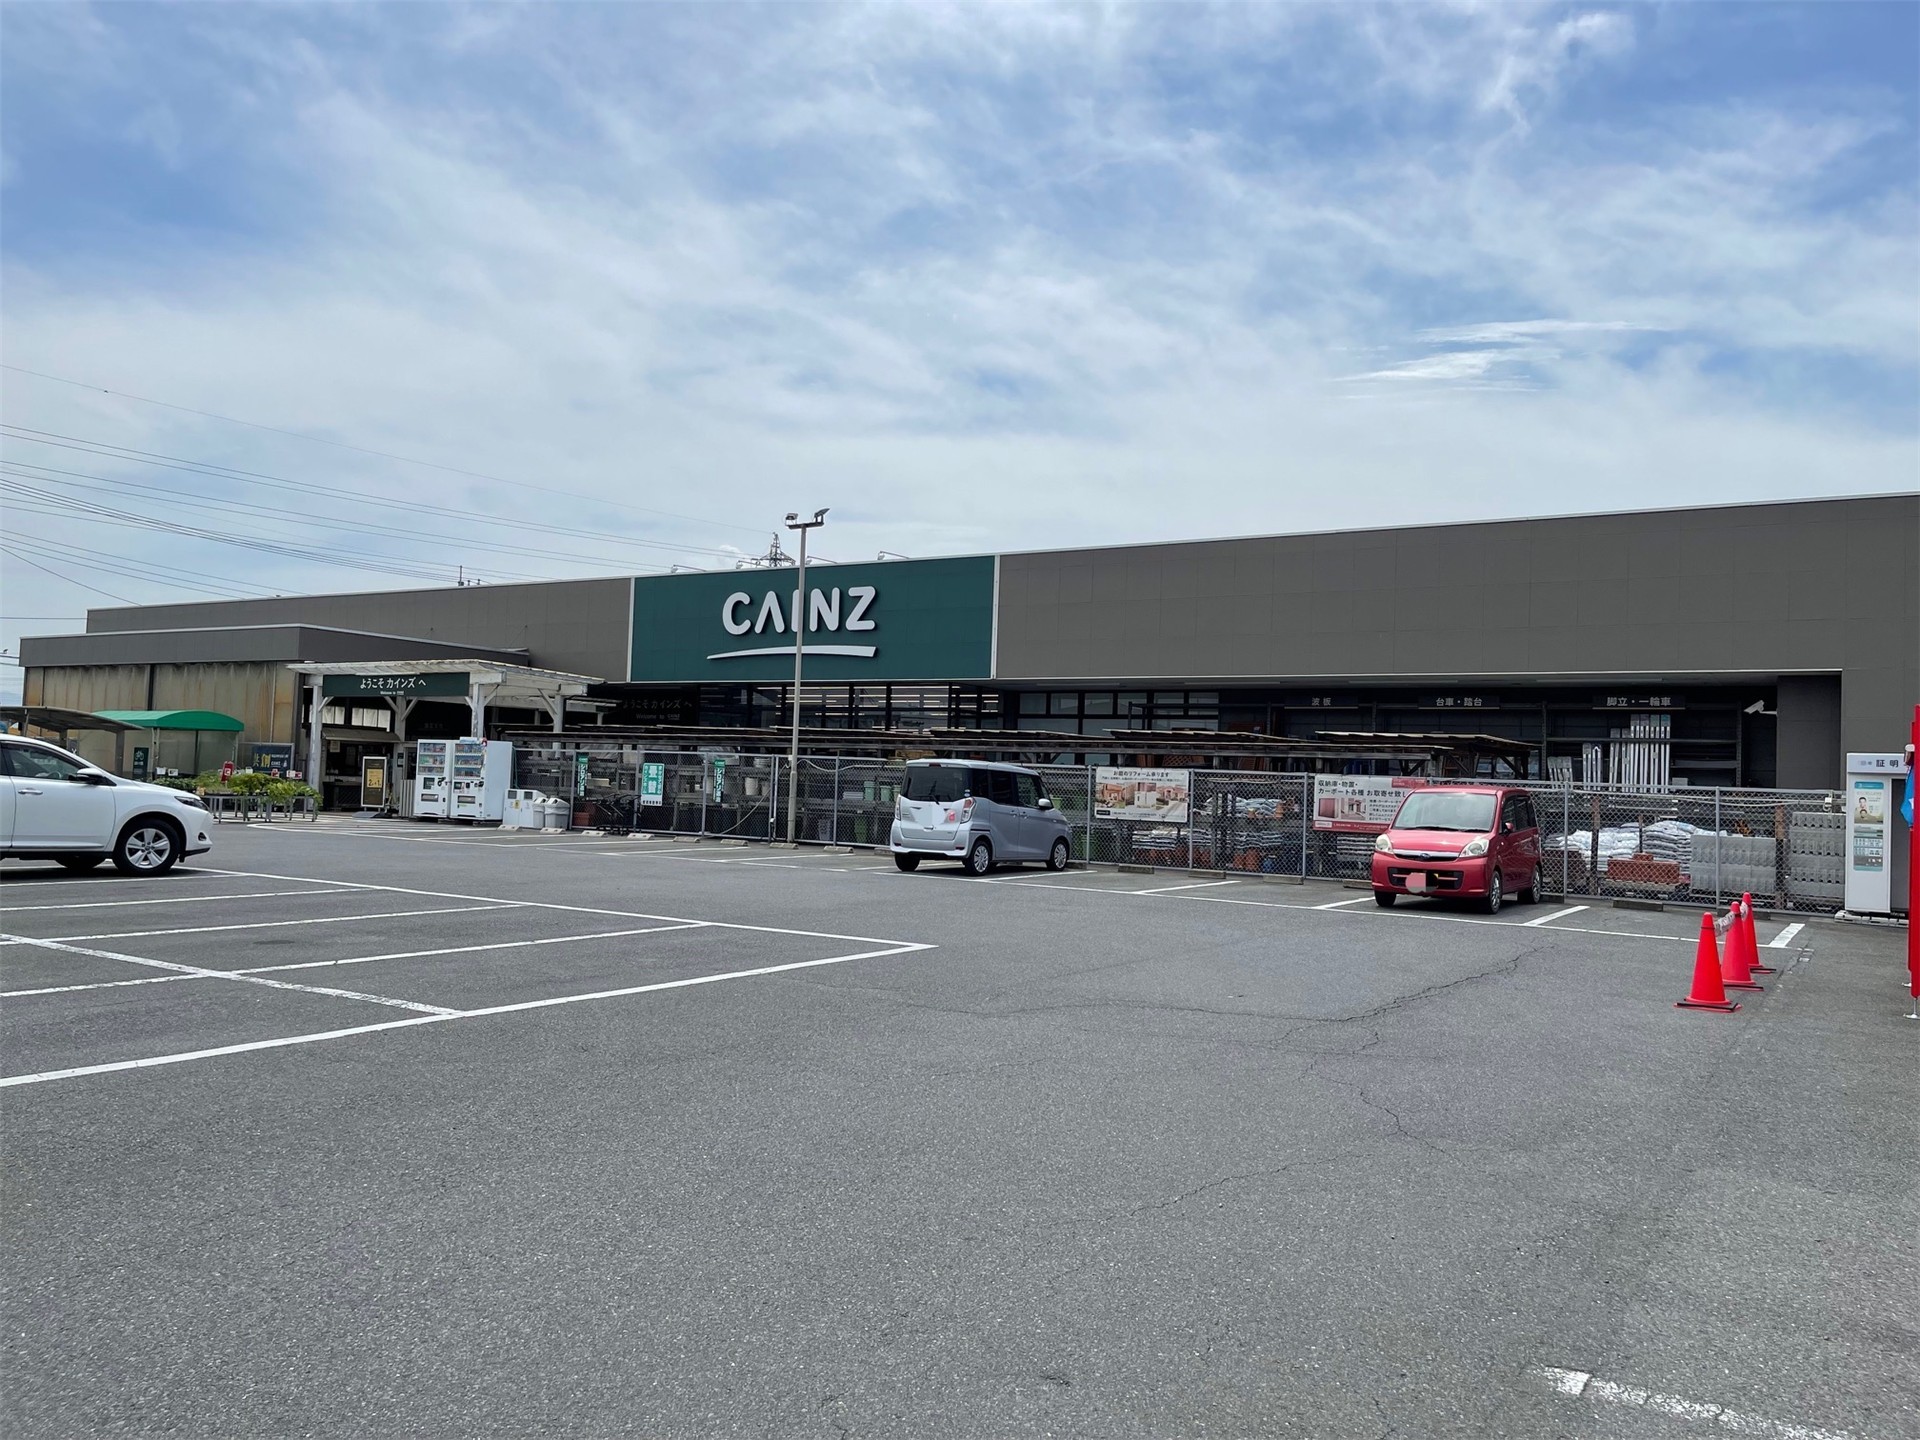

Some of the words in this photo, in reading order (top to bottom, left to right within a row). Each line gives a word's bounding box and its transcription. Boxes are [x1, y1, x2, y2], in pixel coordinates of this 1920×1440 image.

[722, 586, 876, 635] CAINZ
[1606, 697, 1672, 707] 脚立・一輪車
